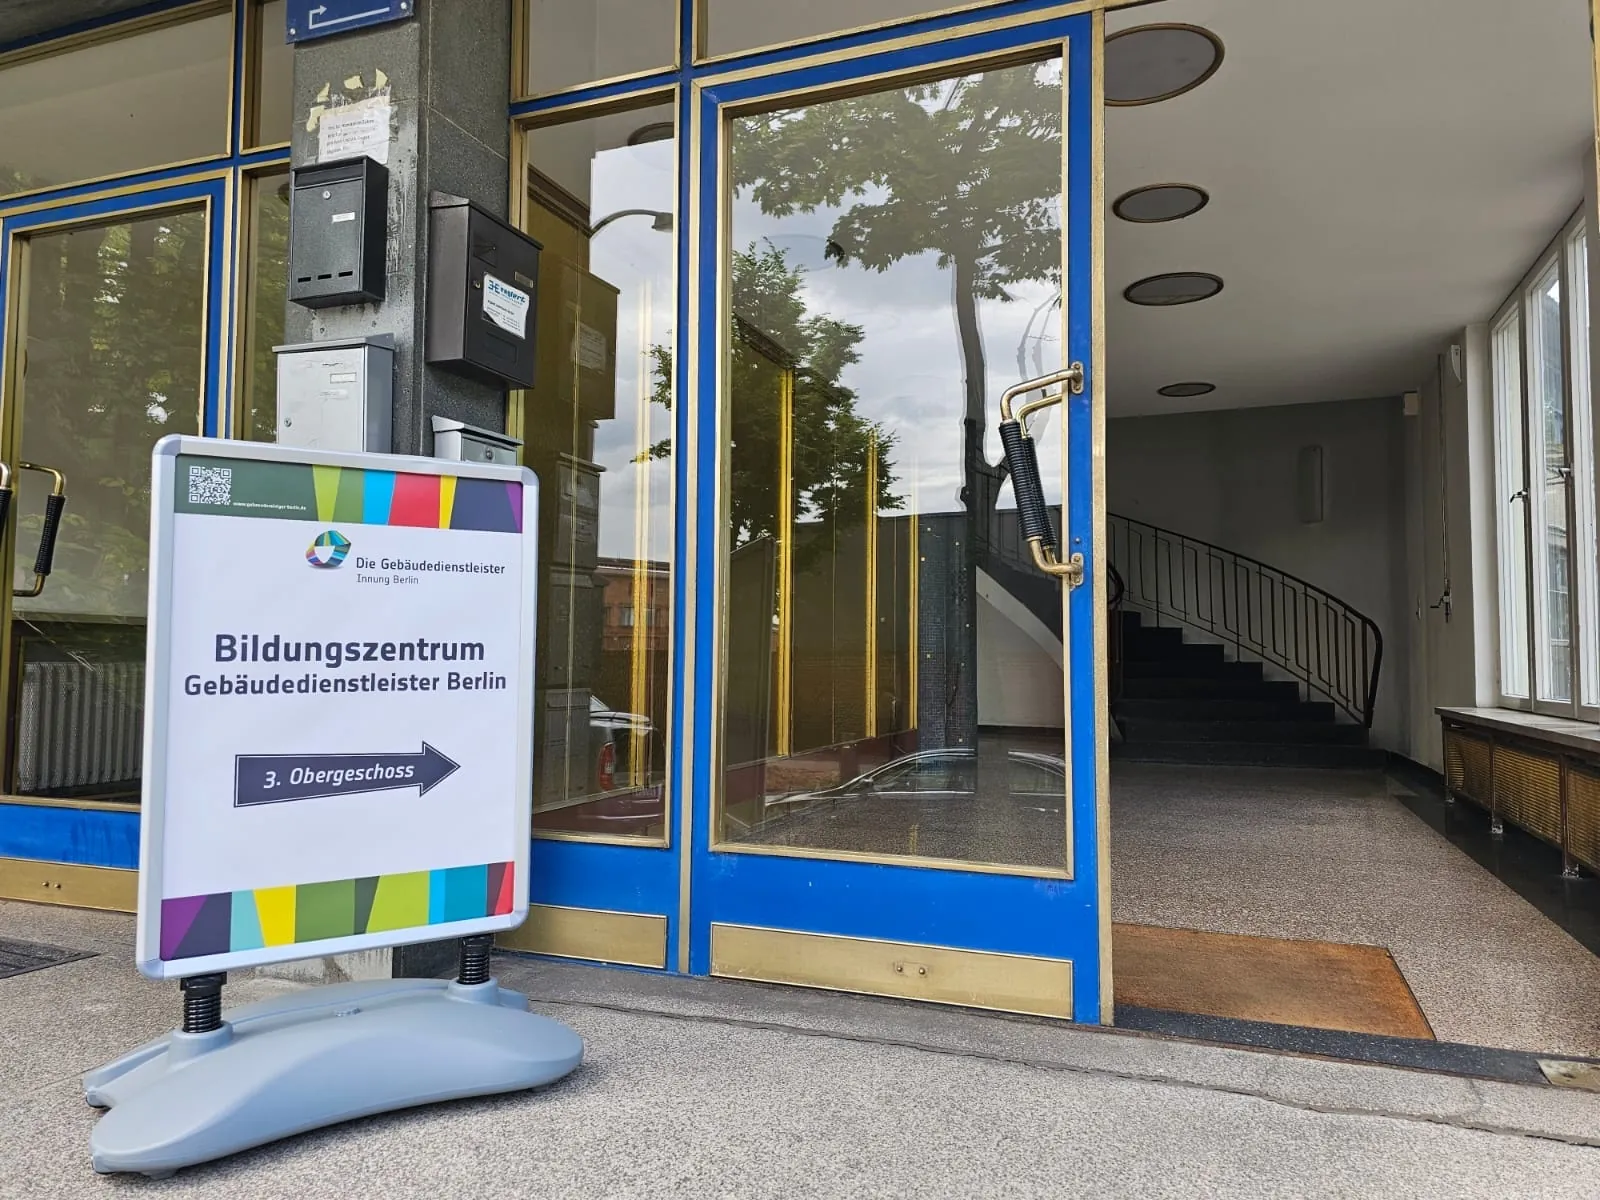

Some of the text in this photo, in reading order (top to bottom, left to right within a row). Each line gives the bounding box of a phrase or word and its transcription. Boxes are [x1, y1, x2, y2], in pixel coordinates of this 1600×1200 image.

[356, 557, 506, 574] Die Gebäudedienstleister
[356, 573, 419, 586] Innung Berlin
[215, 633, 485, 669] Bildungszentrum
[184, 671, 506, 696] Gebäudedienstleister Berlin
[263, 763, 415, 789] 3. Obergeschoss
